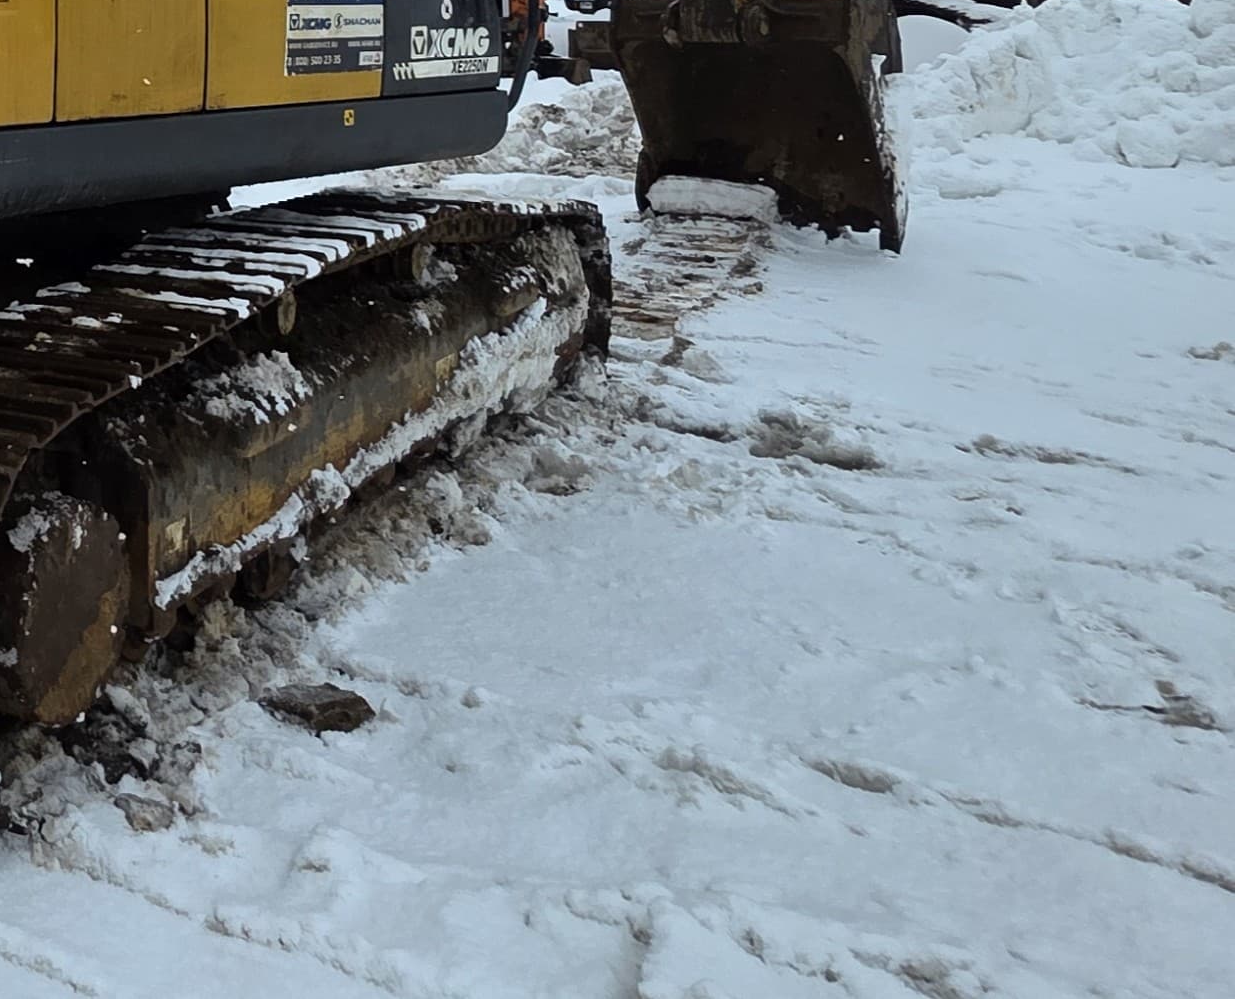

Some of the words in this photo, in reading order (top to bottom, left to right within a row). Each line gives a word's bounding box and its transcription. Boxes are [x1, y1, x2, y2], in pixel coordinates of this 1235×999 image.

[301, 17, 332, 30] XCMG
[344, 17, 381, 26] SHACMAN
[428, 26, 490, 57] XCMG
[451, 58, 489, 74] XE225DN
